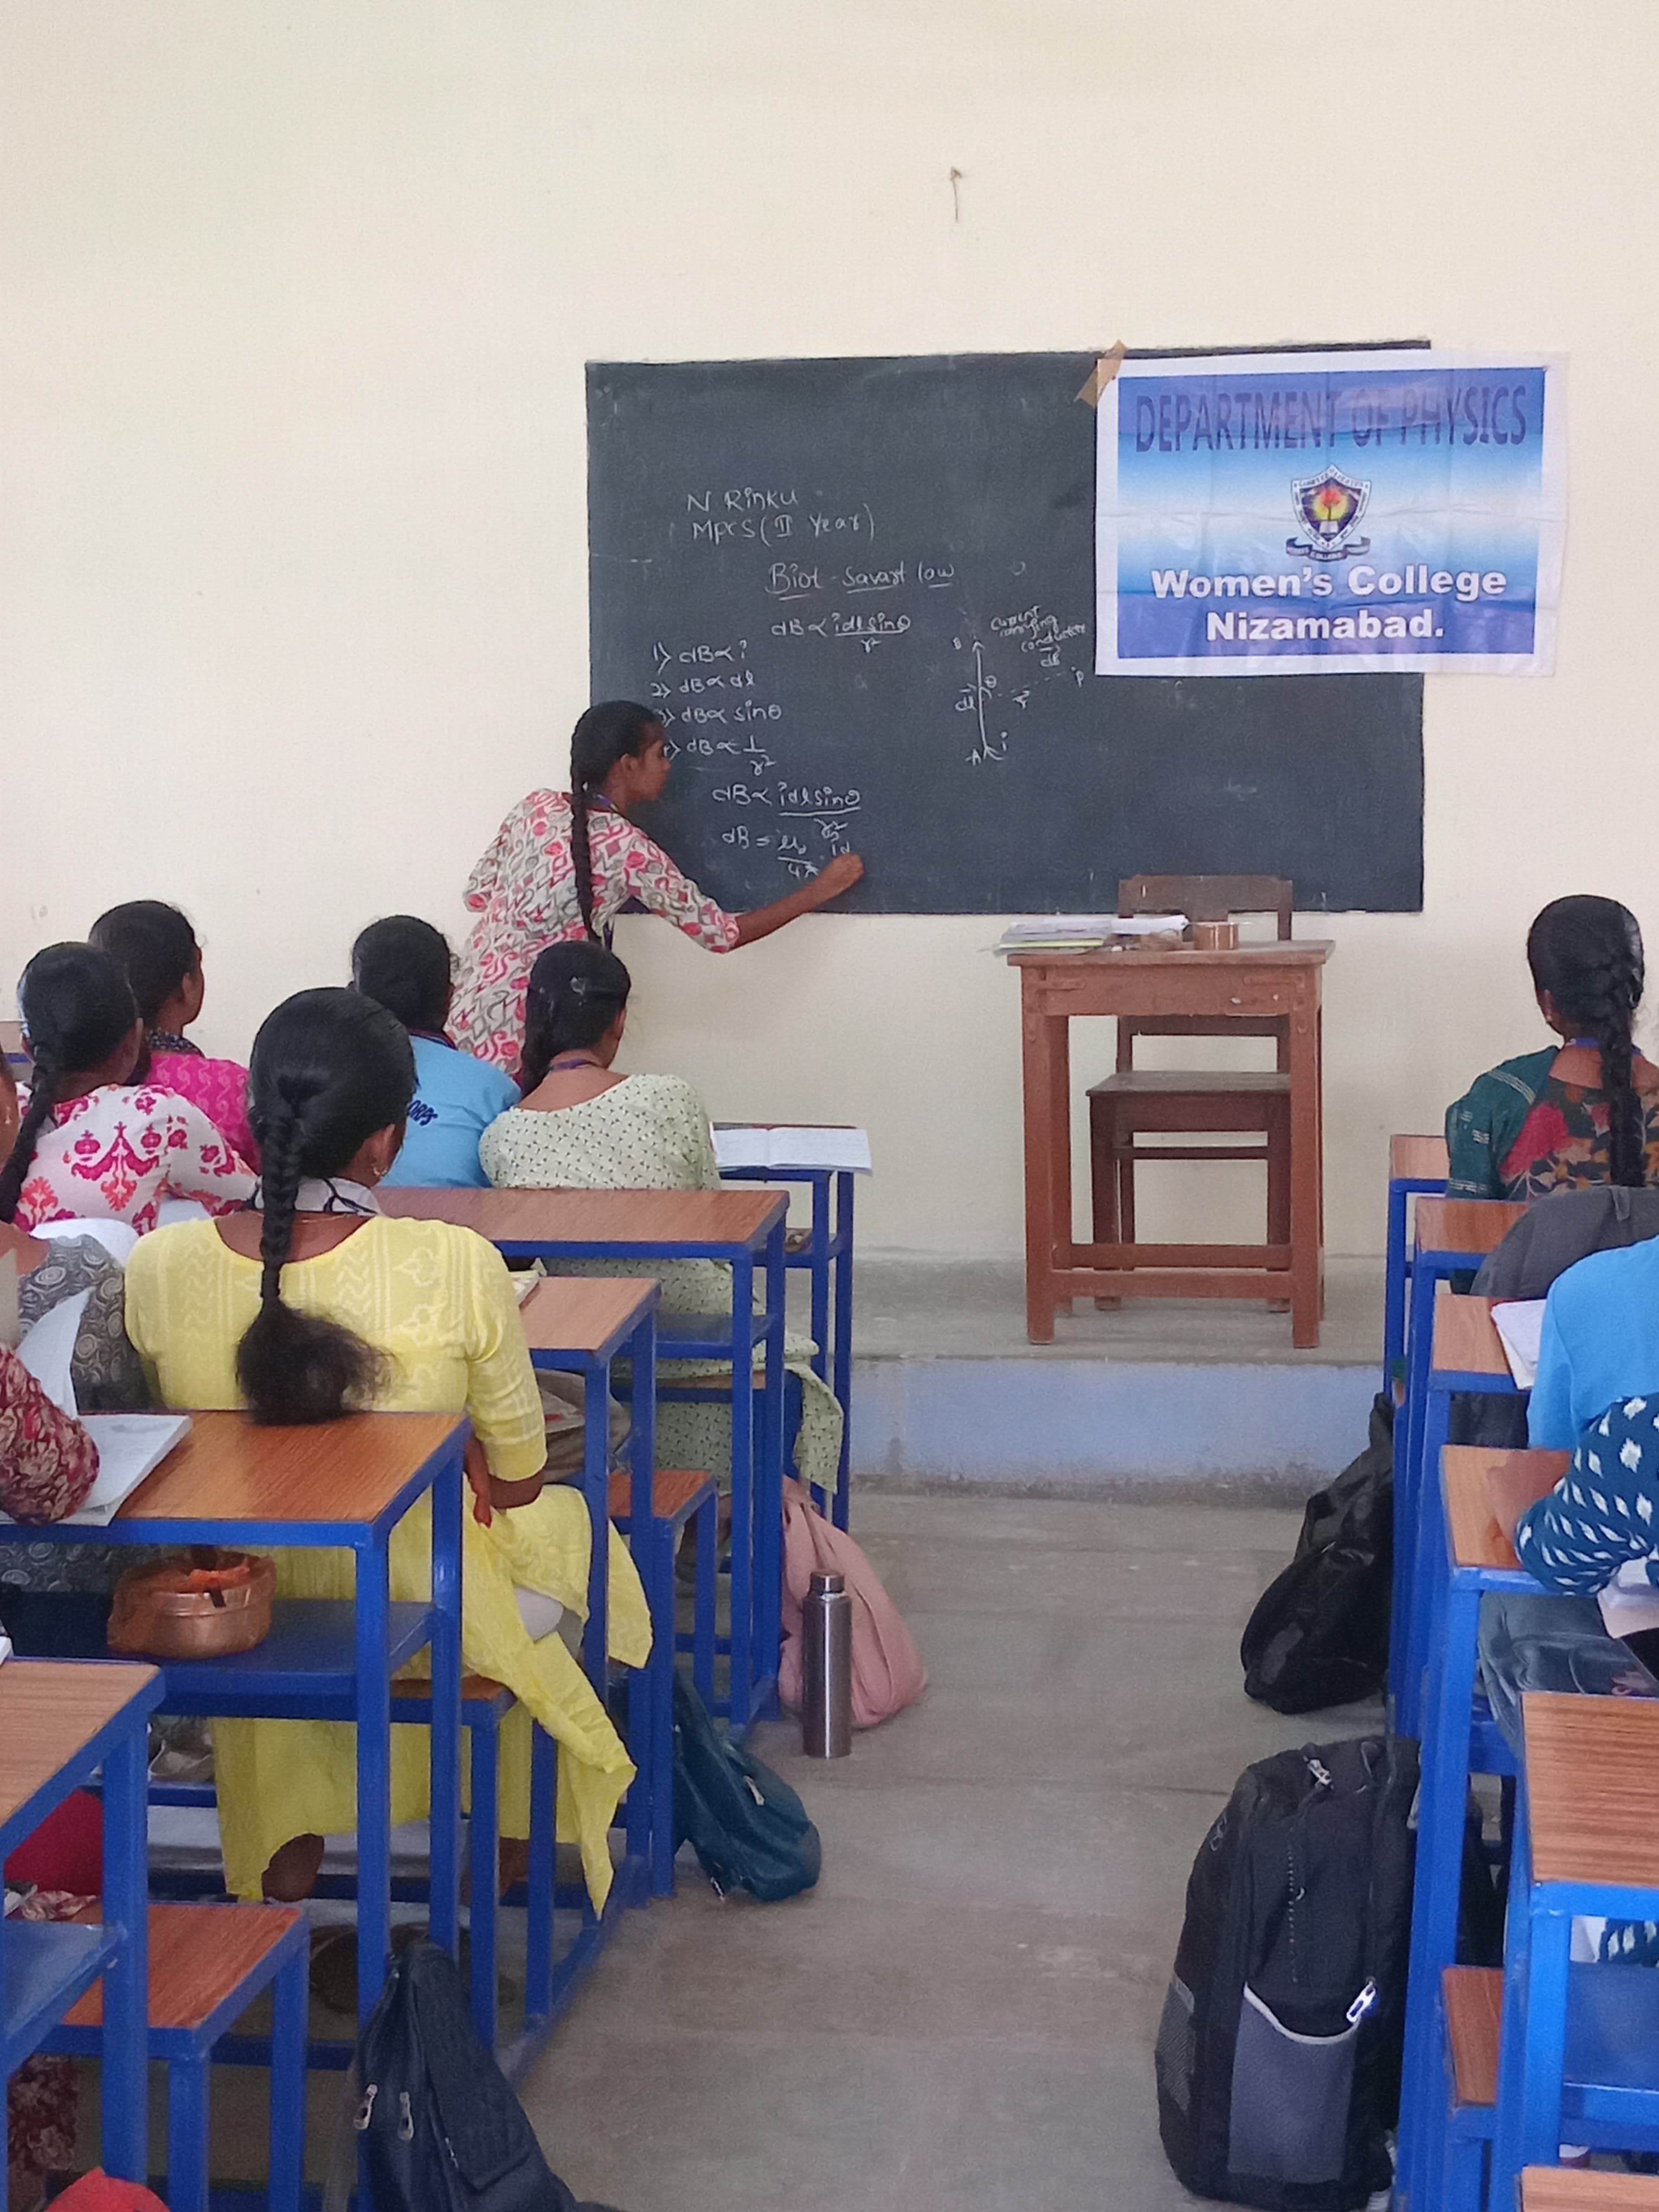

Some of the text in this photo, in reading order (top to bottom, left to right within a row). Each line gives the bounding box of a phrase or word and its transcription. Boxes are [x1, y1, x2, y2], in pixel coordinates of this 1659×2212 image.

[1136, 385, 1527, 453] DEPARTMENT OF PHYSICS
[687, 491, 711, 512] N
[764, 562, 824, 595] Biot
[1150, 564, 1508, 603] Women's College
[1206, 608, 1445, 643] Nizamabad.
